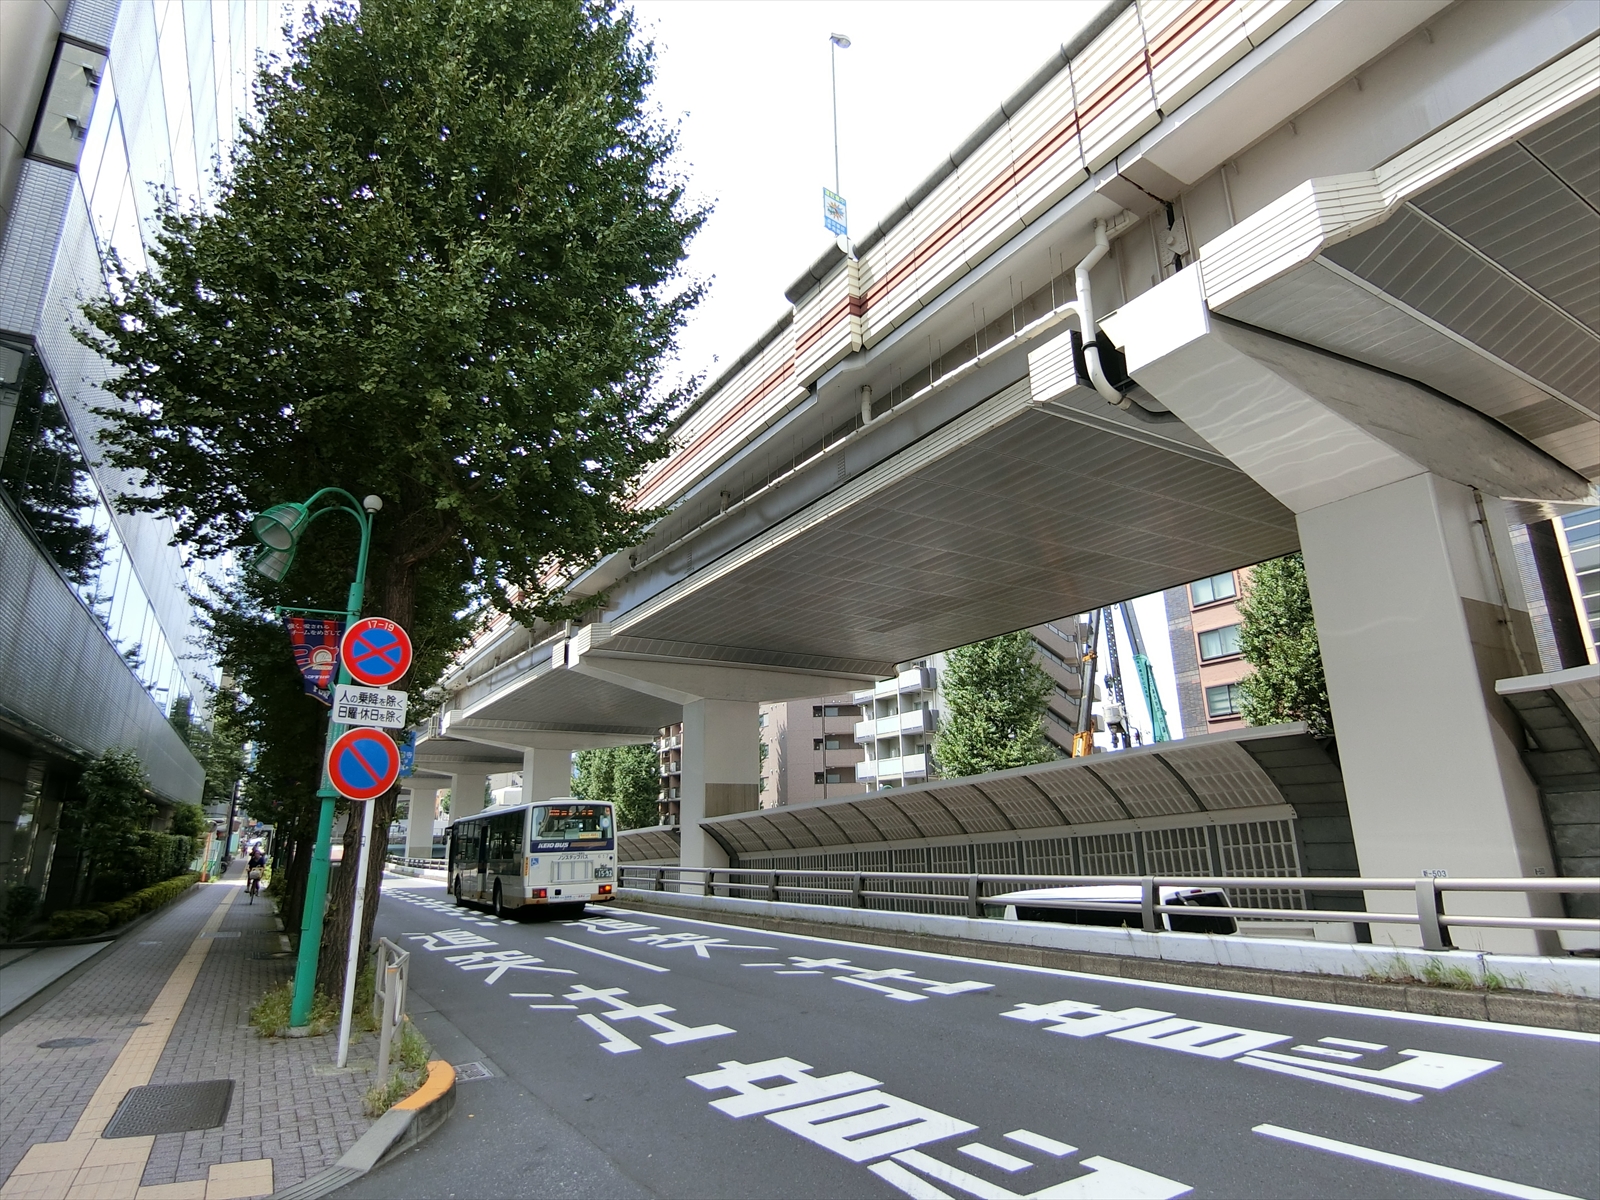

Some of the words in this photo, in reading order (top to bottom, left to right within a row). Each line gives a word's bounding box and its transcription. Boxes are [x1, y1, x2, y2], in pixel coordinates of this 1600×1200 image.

[367, 620, 395, 632] 17-19
[339, 690, 404, 708] 人の乗降を除く
[338, 706, 402, 723] 日曜・休日を除く
